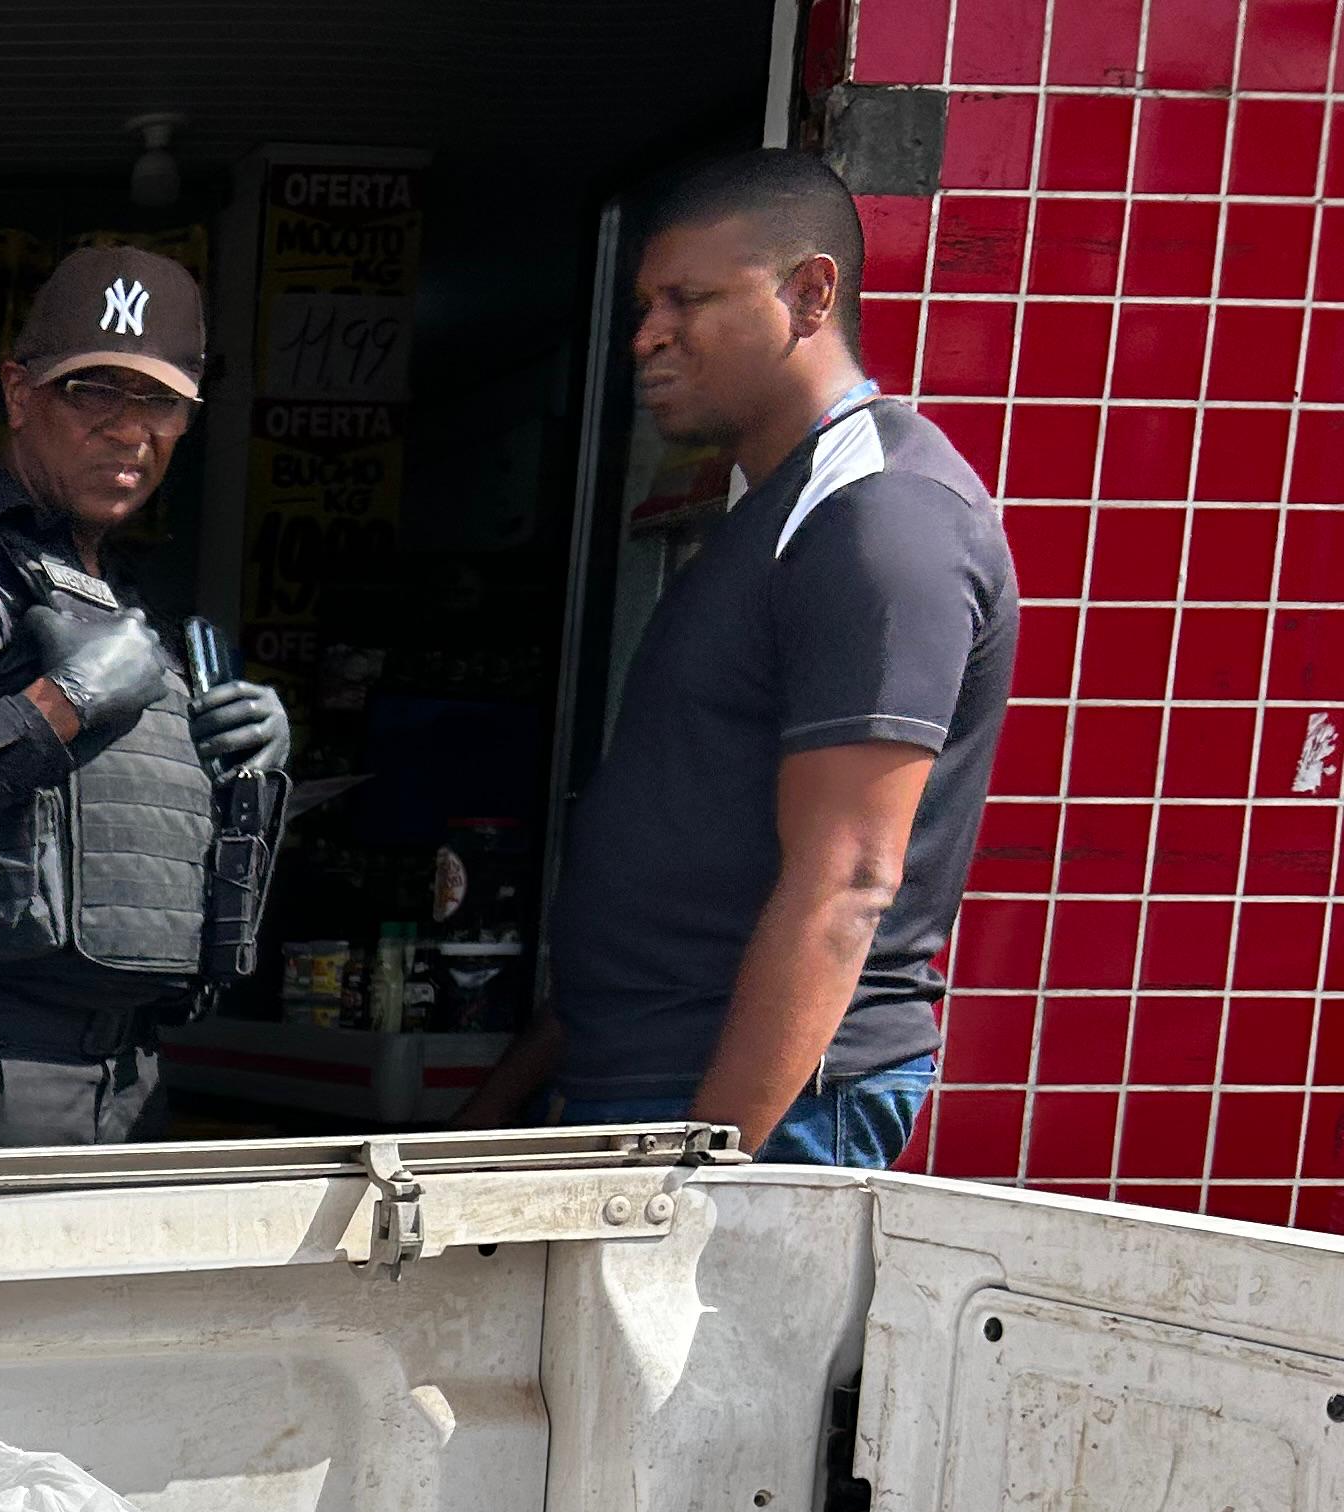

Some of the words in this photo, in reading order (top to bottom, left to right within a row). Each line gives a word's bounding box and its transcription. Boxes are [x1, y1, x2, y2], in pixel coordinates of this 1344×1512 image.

[284, 172, 411, 209] OFERTA
[98, 277, 151, 337] NY
[265, 404, 394, 438] OFERTA
